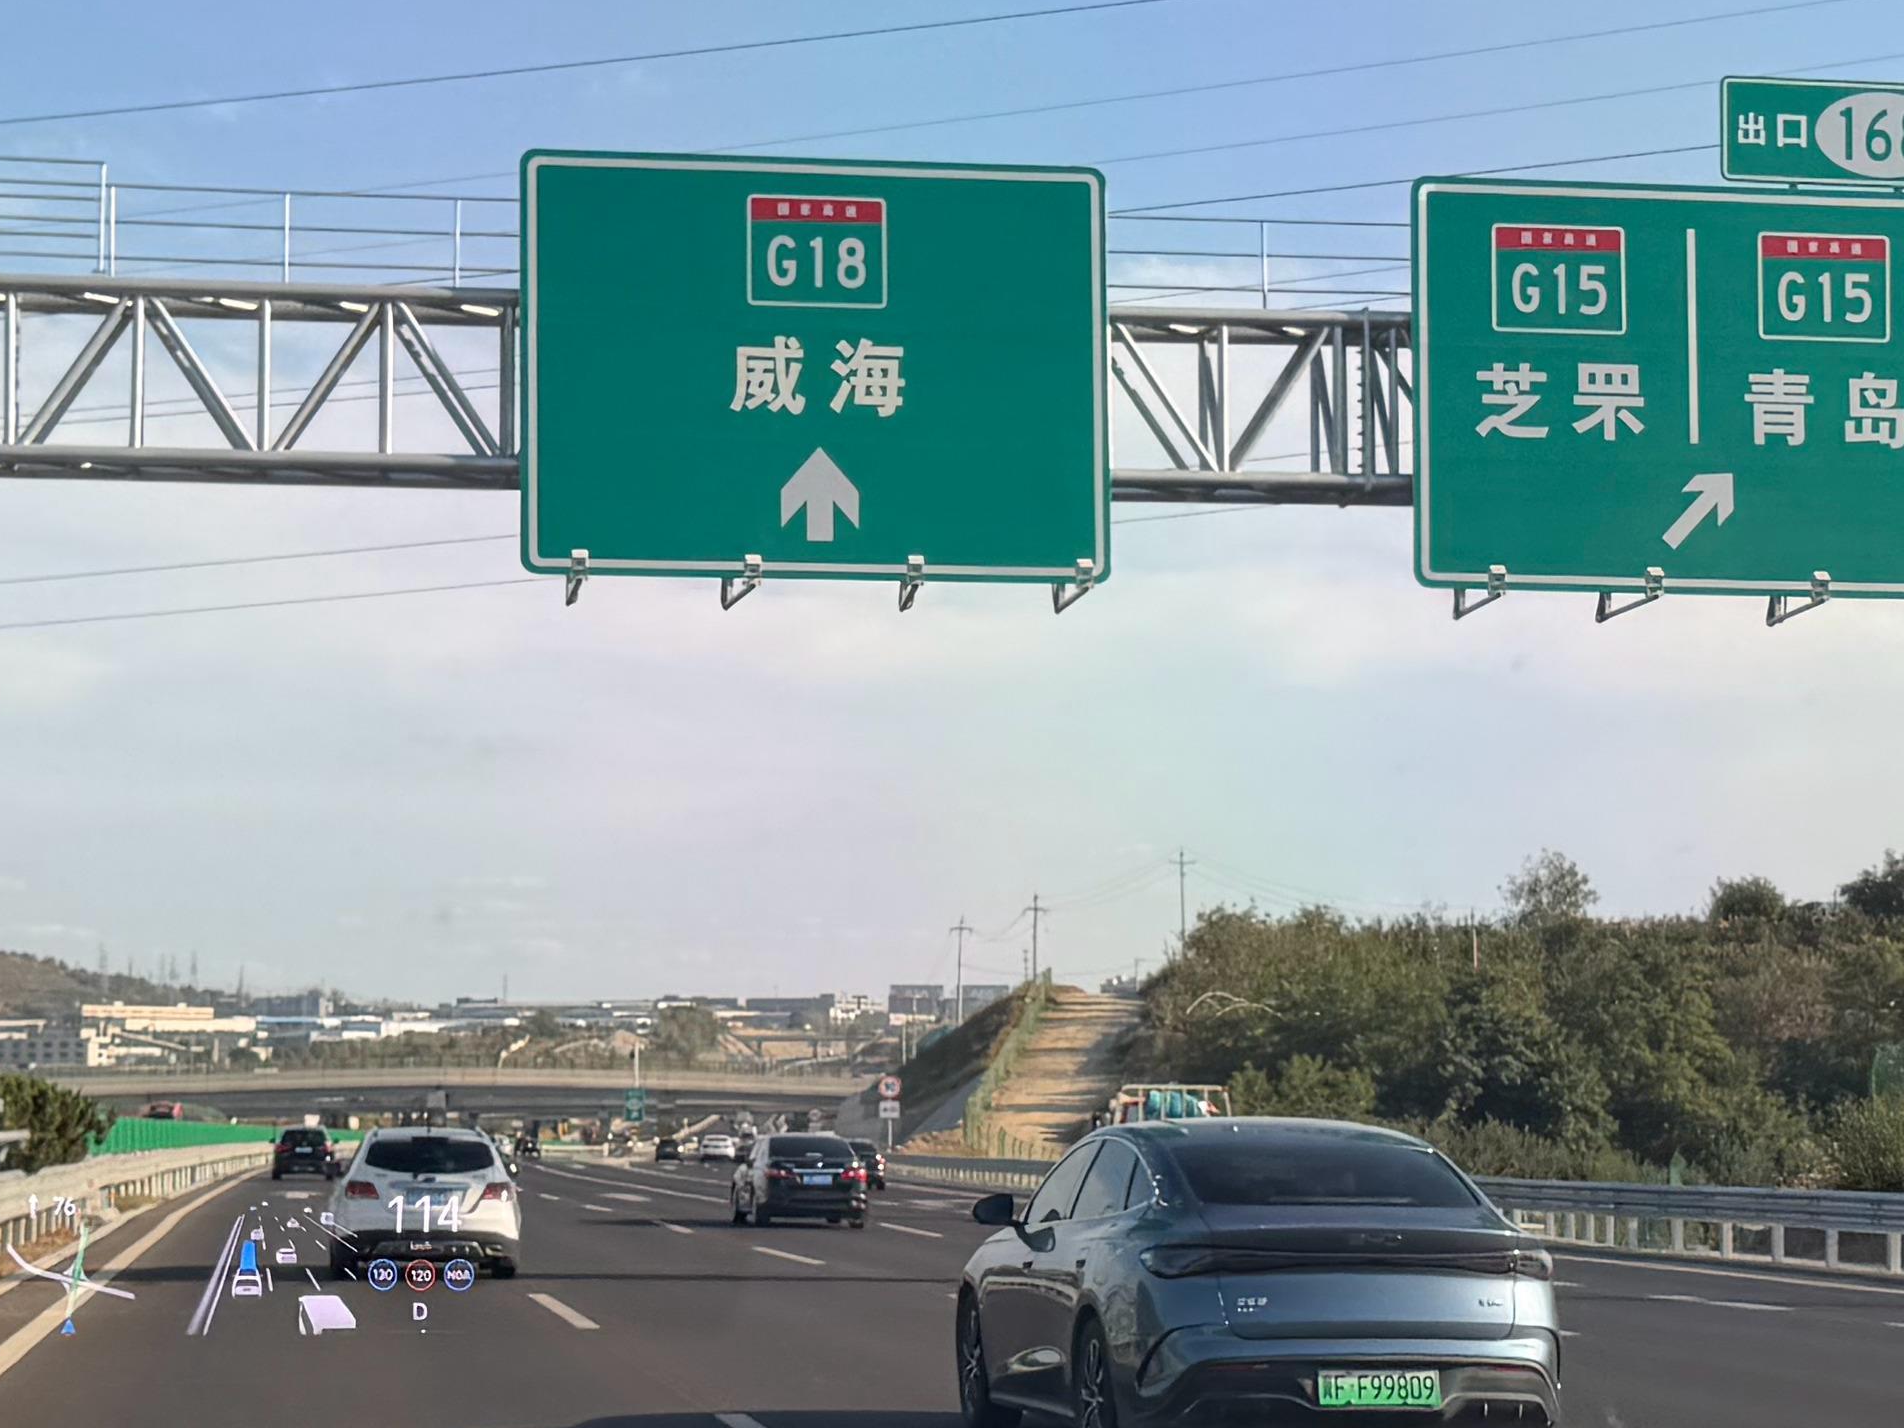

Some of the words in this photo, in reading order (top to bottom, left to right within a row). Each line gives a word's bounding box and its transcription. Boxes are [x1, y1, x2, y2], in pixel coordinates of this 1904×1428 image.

[1737, 112, 1808, 148] 出口
[767, 235, 866, 289] G18
[1512, 263, 1607, 315] G15
[1778, 271, 1872, 323] G15
[729, 335, 906, 417] 威海
[1475, 362, 1645, 441] 芝罘
[52, 1196, 77, 1216] 76
[388, 1195, 463, 1233] 114
[411, 1269, 432, 1282] 120
[412, 1302, 428, 1320] D
